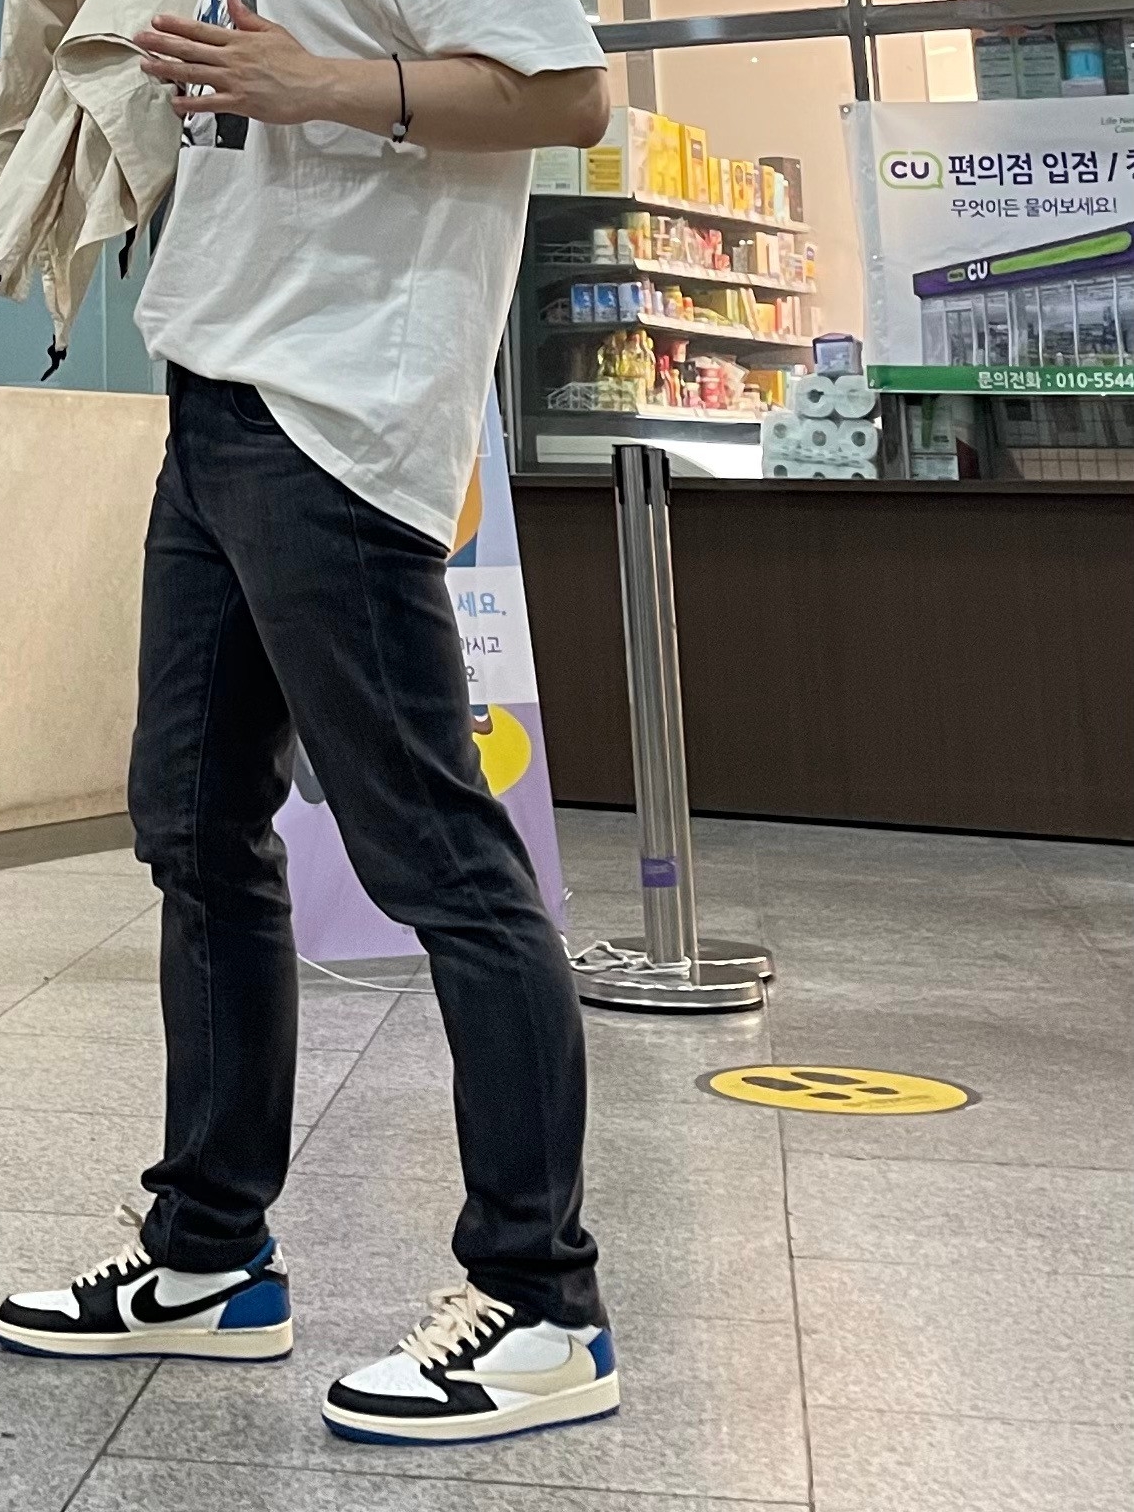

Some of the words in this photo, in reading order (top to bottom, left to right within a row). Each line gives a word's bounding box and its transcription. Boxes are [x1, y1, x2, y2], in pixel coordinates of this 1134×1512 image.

[891, 160, 930, 180] CU
[948, 153, 1033, 186] 편의점
[1042, 151, 1098, 184] 입점
[951, 197, 1020, 218] 무엇이든
[1025, 197, 1117, 217] 물어보세요!
[967, 261, 989, 281] CU
[978, 371, 1041, 389] 문의전화
